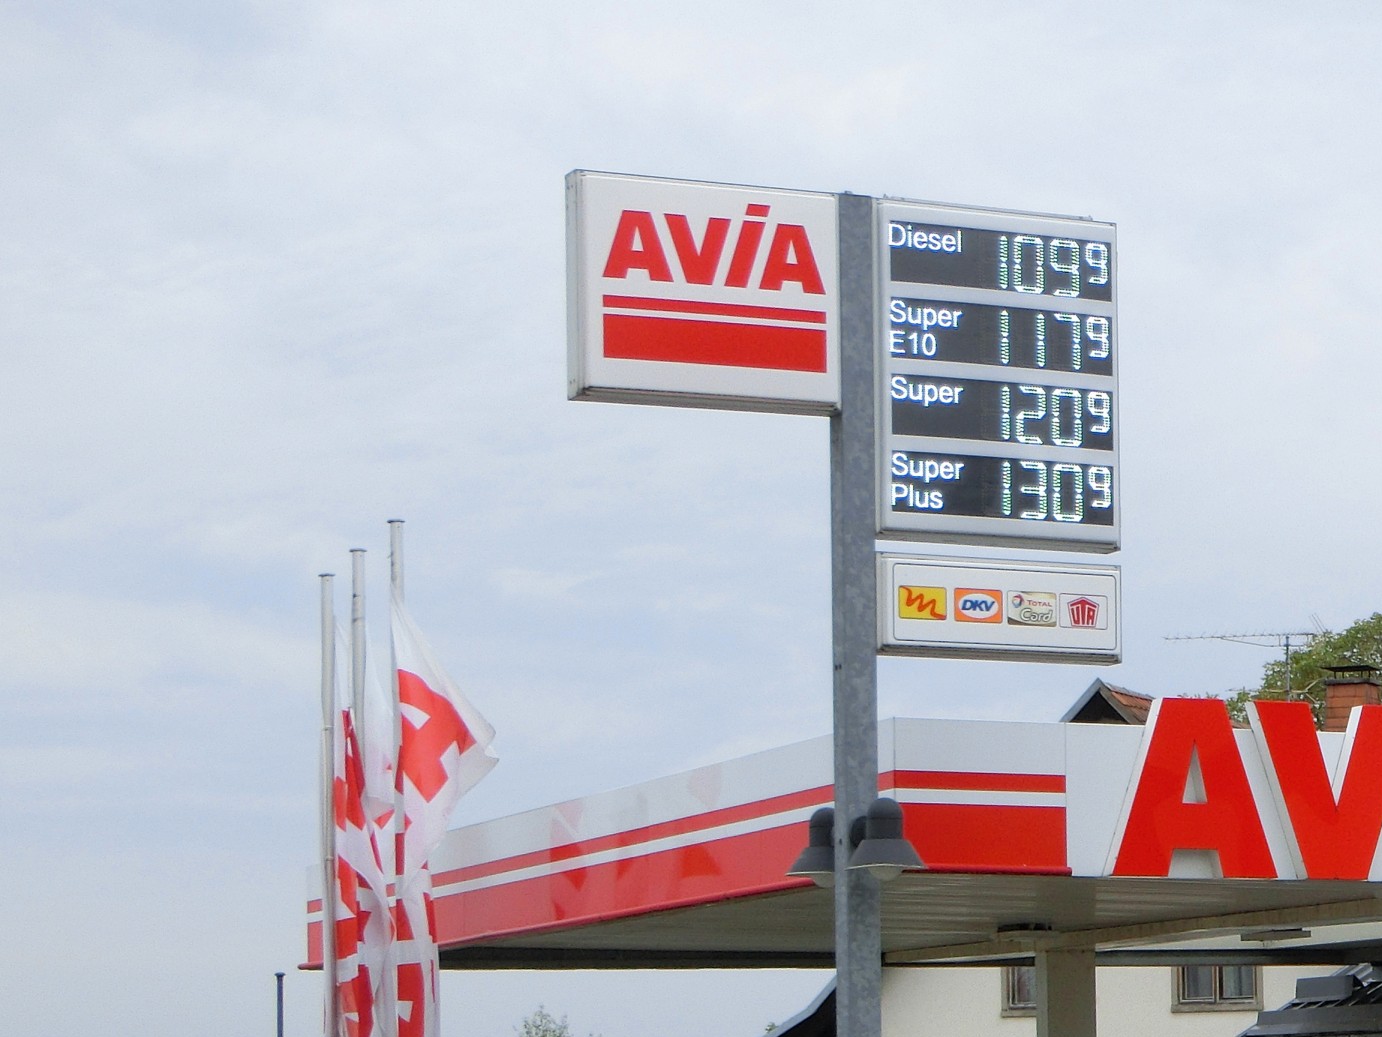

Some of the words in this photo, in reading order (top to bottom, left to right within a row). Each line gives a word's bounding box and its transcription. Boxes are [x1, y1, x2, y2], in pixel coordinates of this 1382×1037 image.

[602, 203, 826, 295] AVIA
[888, 223, 963, 254] Diesel
[890, 300, 962, 329] Super
[889, 332, 937, 357] E10
[891, 376, 963, 406] Super
[891, 453, 964, 482] Super
[891, 484, 944, 510] Plus
[961, 599, 995, 612] DKV
[1020, 608, 1053, 623] Card
